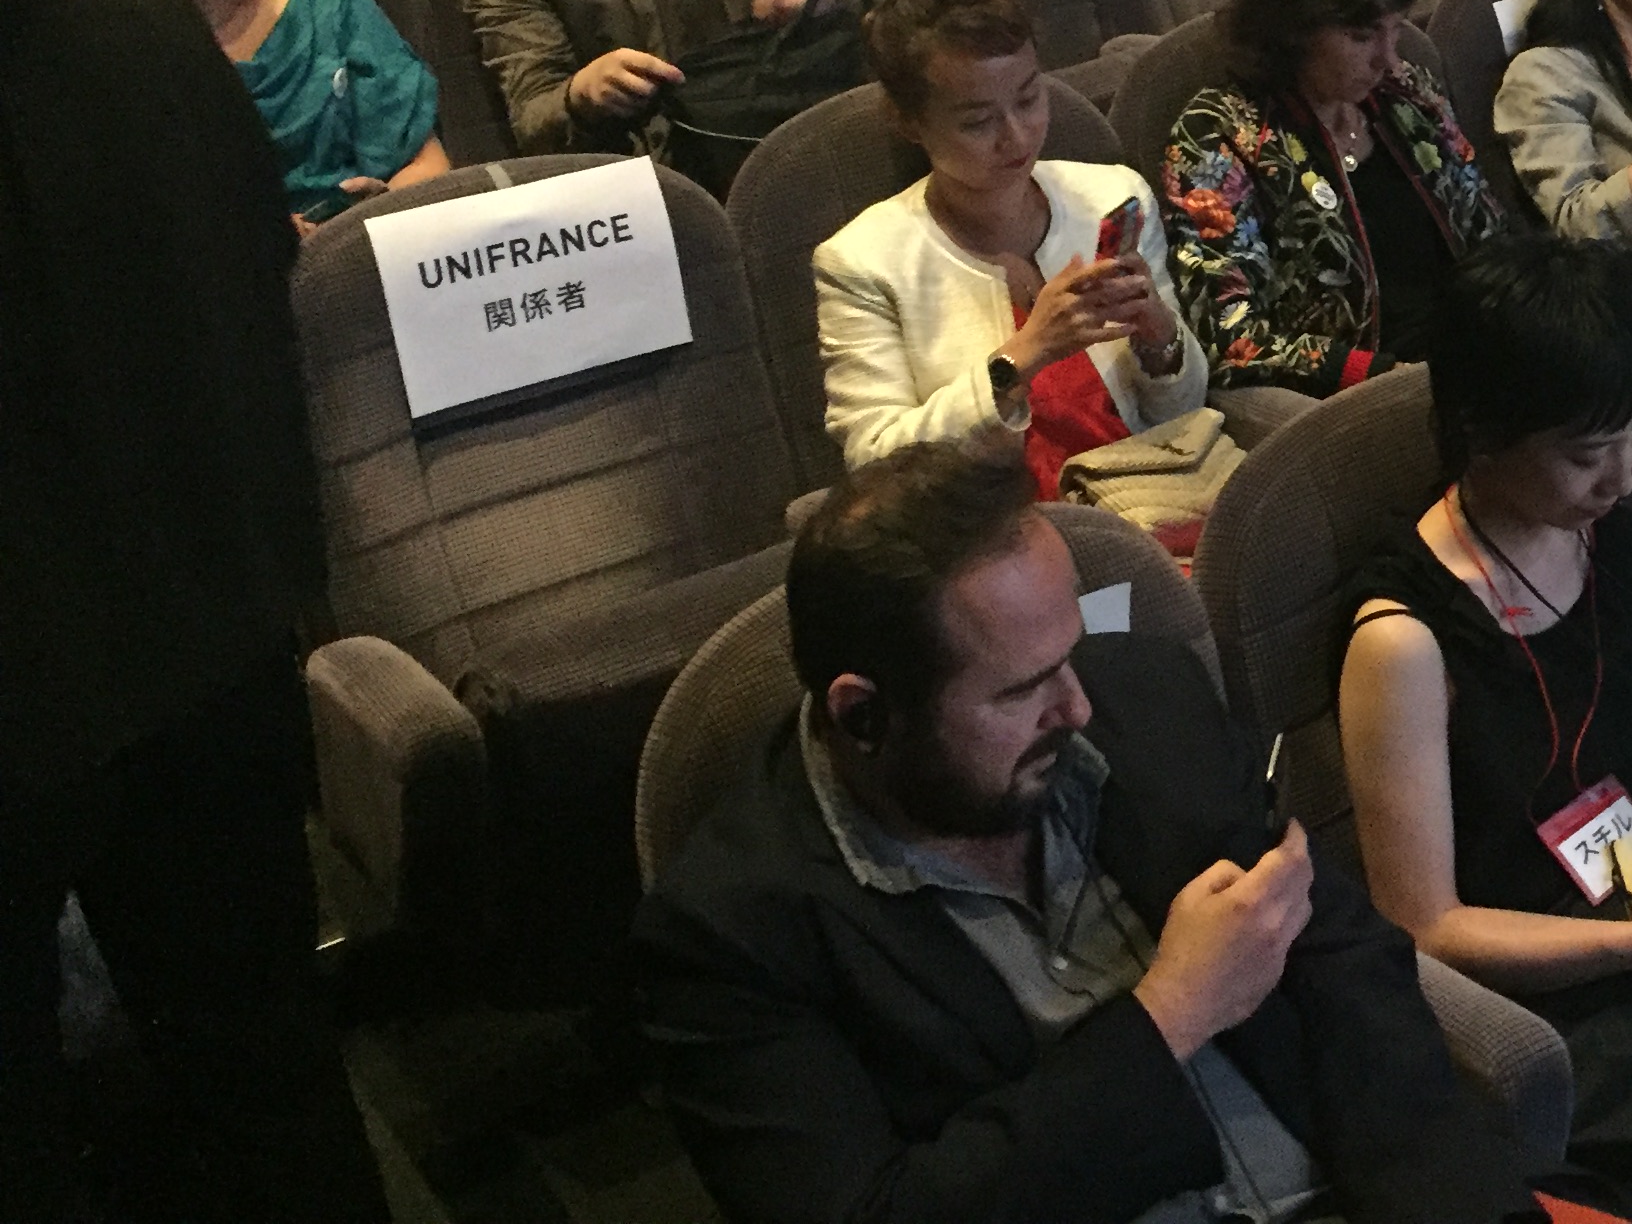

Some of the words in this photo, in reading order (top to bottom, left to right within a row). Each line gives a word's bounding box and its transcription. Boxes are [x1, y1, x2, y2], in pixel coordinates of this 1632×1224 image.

[417, 213, 634, 289] UNIFRANCE
[483, 279, 587, 333] 関係者
